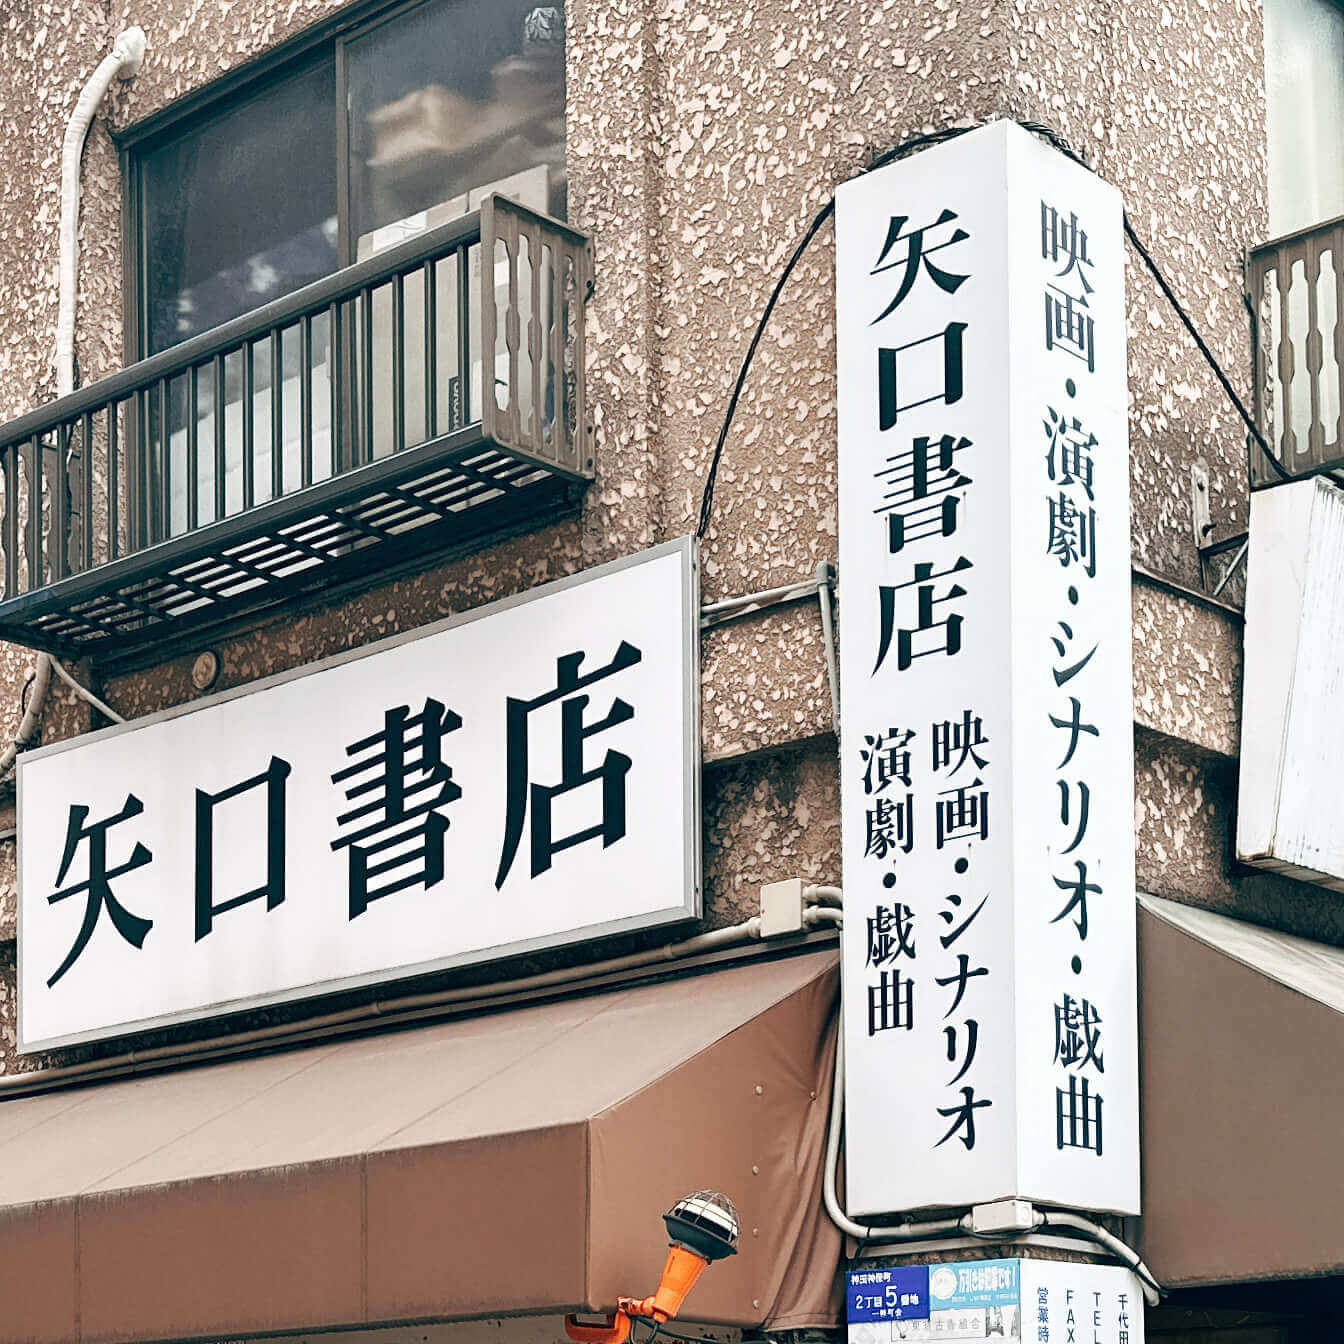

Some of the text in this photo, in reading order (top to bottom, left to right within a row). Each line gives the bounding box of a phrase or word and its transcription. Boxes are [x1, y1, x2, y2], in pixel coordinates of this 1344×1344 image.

[869, 208, 974, 678] 矢口書店
[46, 639, 643, 989] 矢口書店
[859, 727, 917, 1038] 演劇・戯曲
[1040, 198, 1105, 1157] 映画・演劇・シナリオ・戯曲
[930, 709, 993, 1151] 映画・シナリオ
